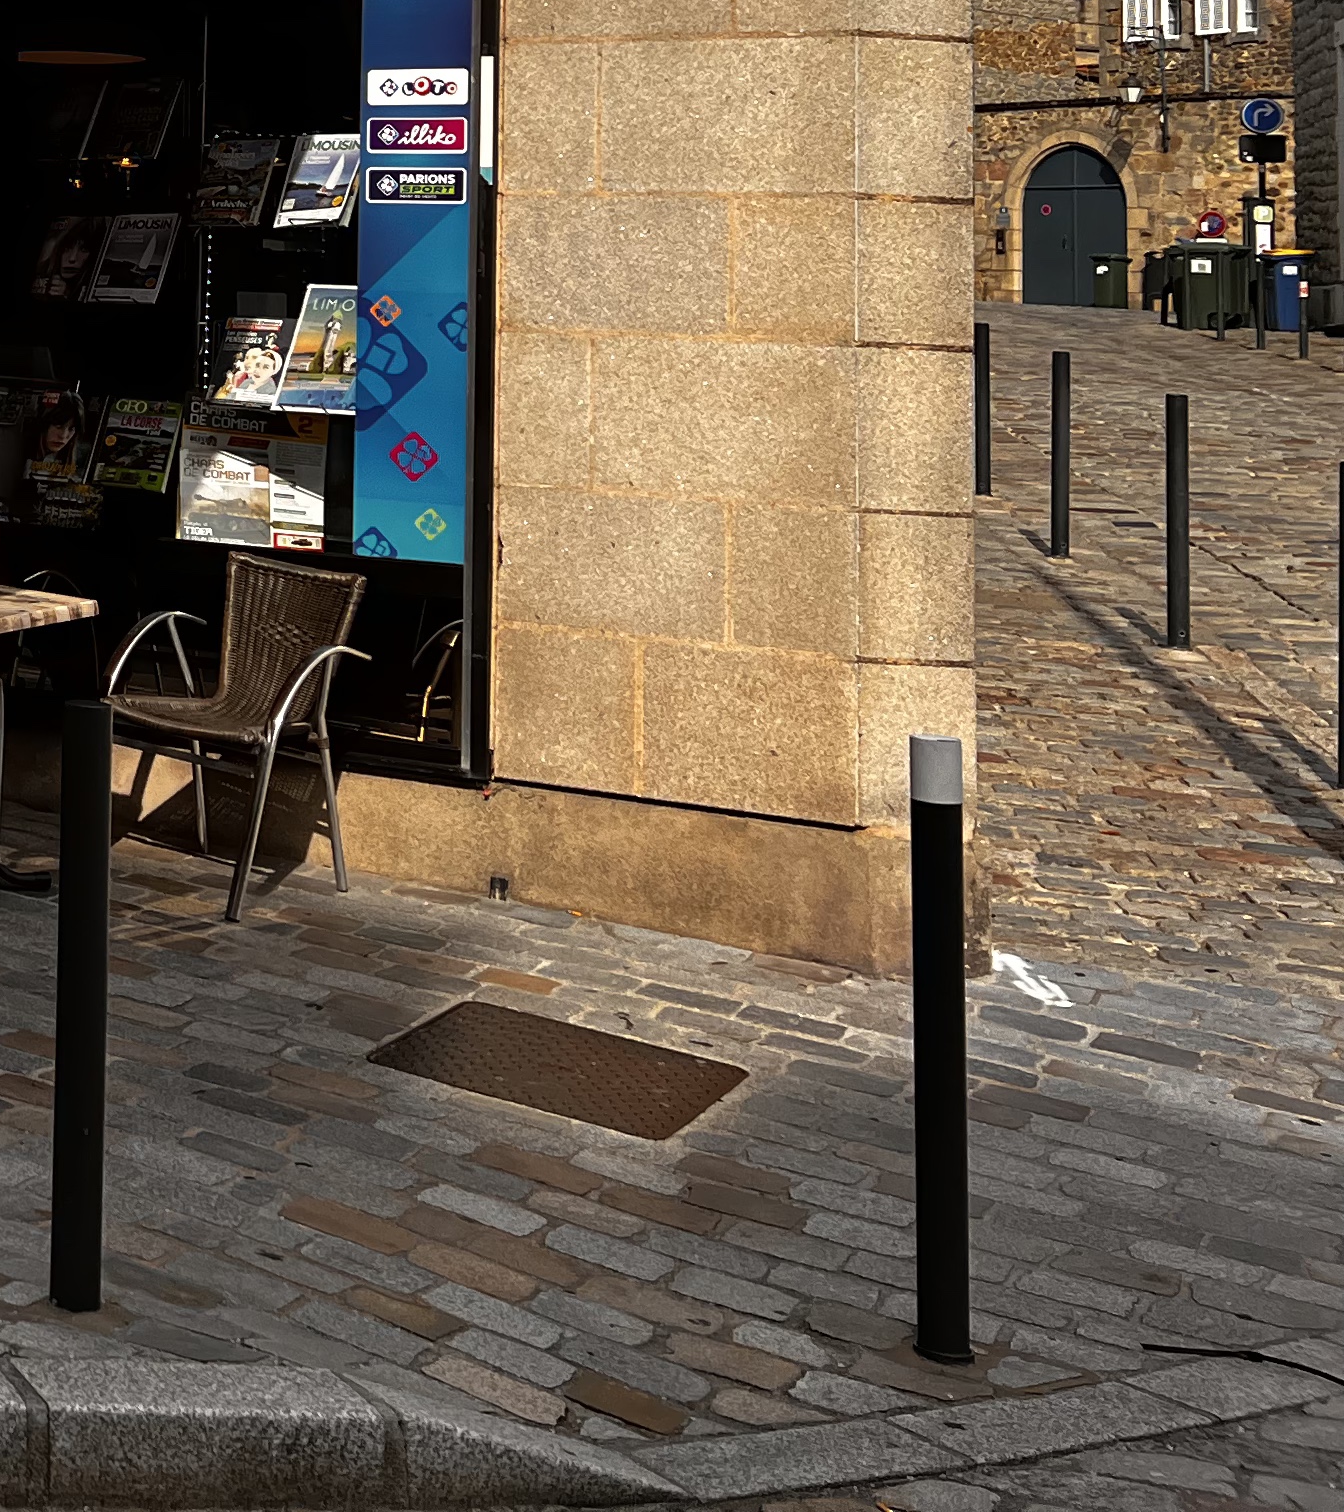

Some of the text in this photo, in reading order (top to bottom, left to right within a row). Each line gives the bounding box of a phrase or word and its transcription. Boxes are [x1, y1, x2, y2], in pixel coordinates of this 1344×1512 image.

[402, 76, 458, 97] LOTO
[397, 123, 457, 145] illiko
[301, 139, 361, 152] LIMOUSIN
[399, 173, 456, 184] PARIONS
[402, 185, 454, 193] SPORT
[118, 218, 173, 230] LIMOUSIN
[116, 399, 147, 414] GEO
[121, 416, 132, 426] LA
[190, 413, 268, 433] DE COMBAT
[298, 416, 312, 434] 2
[184, 457, 224, 469] CHARS
[184, 467, 251, 481] DE COMBAT
